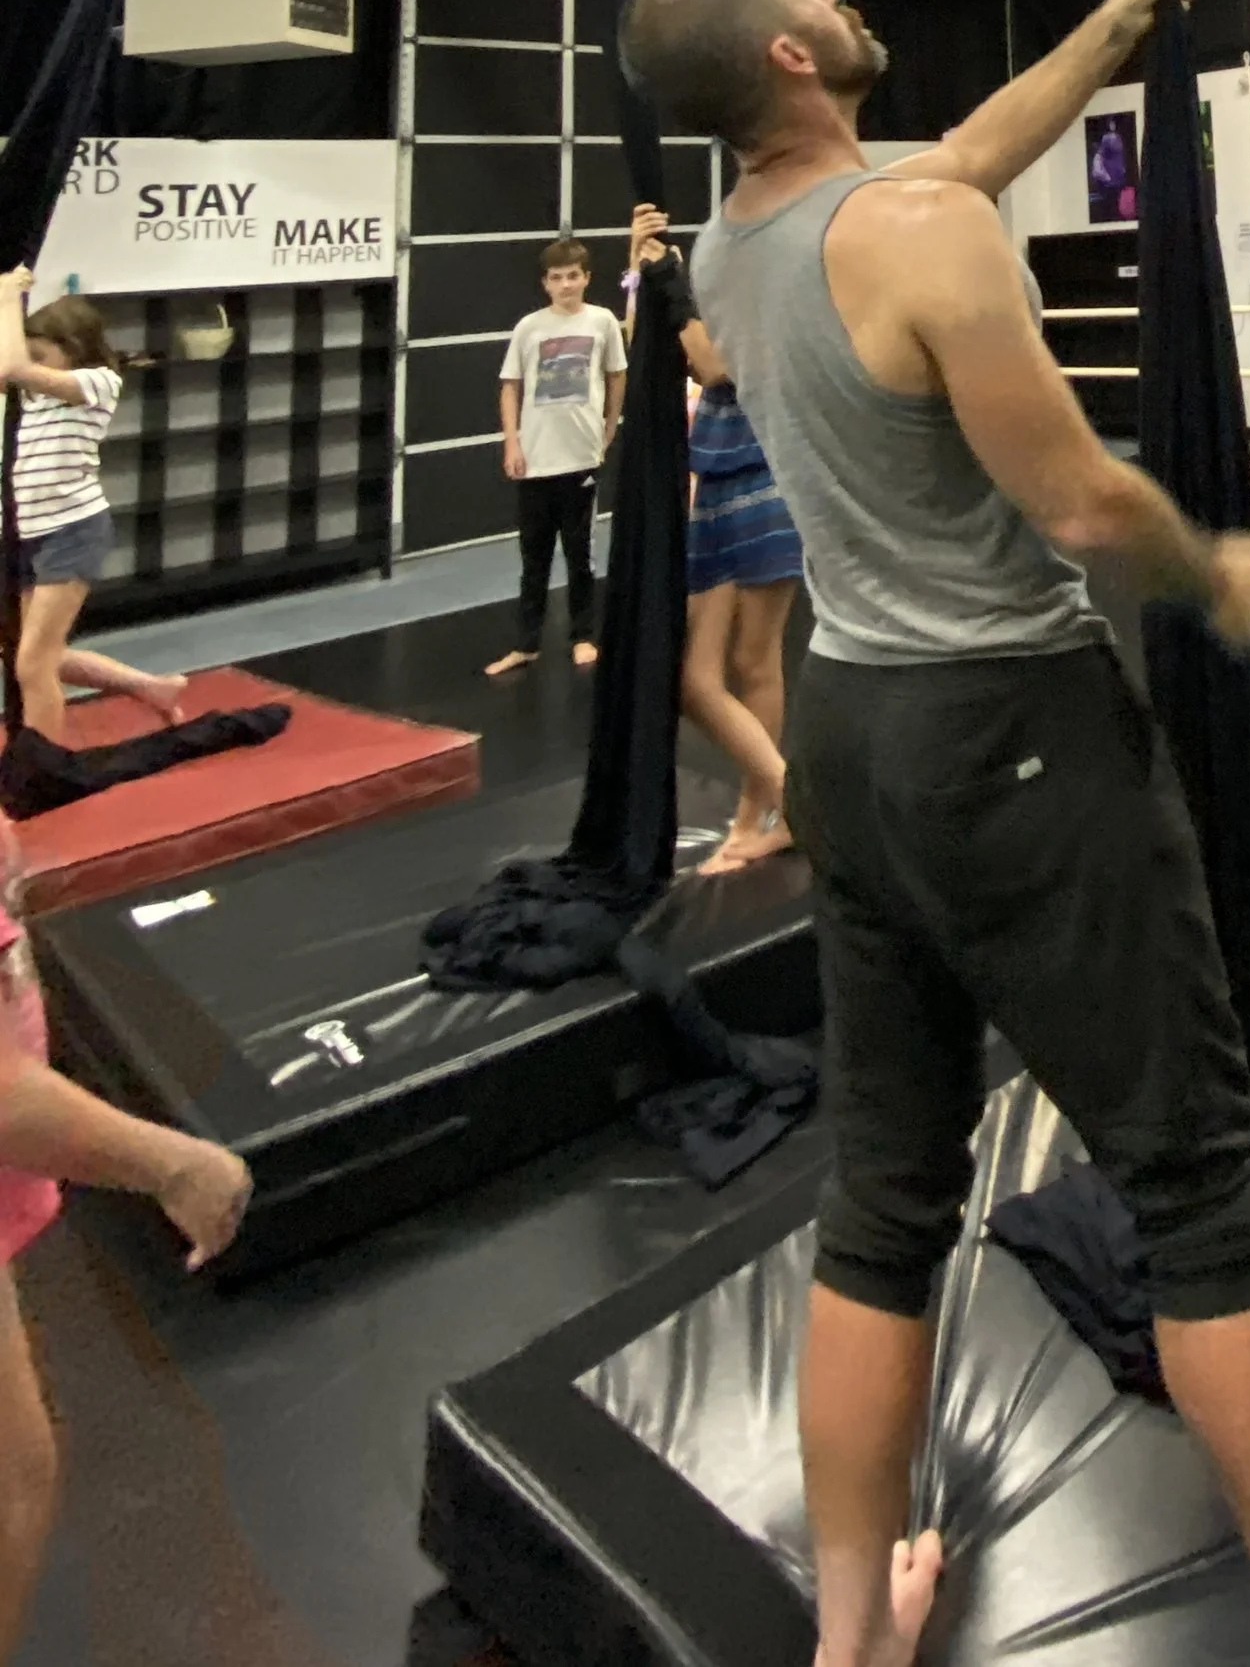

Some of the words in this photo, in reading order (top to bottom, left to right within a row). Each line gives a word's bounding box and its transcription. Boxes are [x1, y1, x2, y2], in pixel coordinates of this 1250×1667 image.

[71, 140, 120, 167] RK
[61, 168, 120, 195] RD
[138, 182, 258, 219] STAY
[135, 217, 258, 242] POSITIVE
[274, 217, 382, 247] MAKE
[272, 248, 291, 266] IT
[296, 245, 382, 265] HAPPEN
